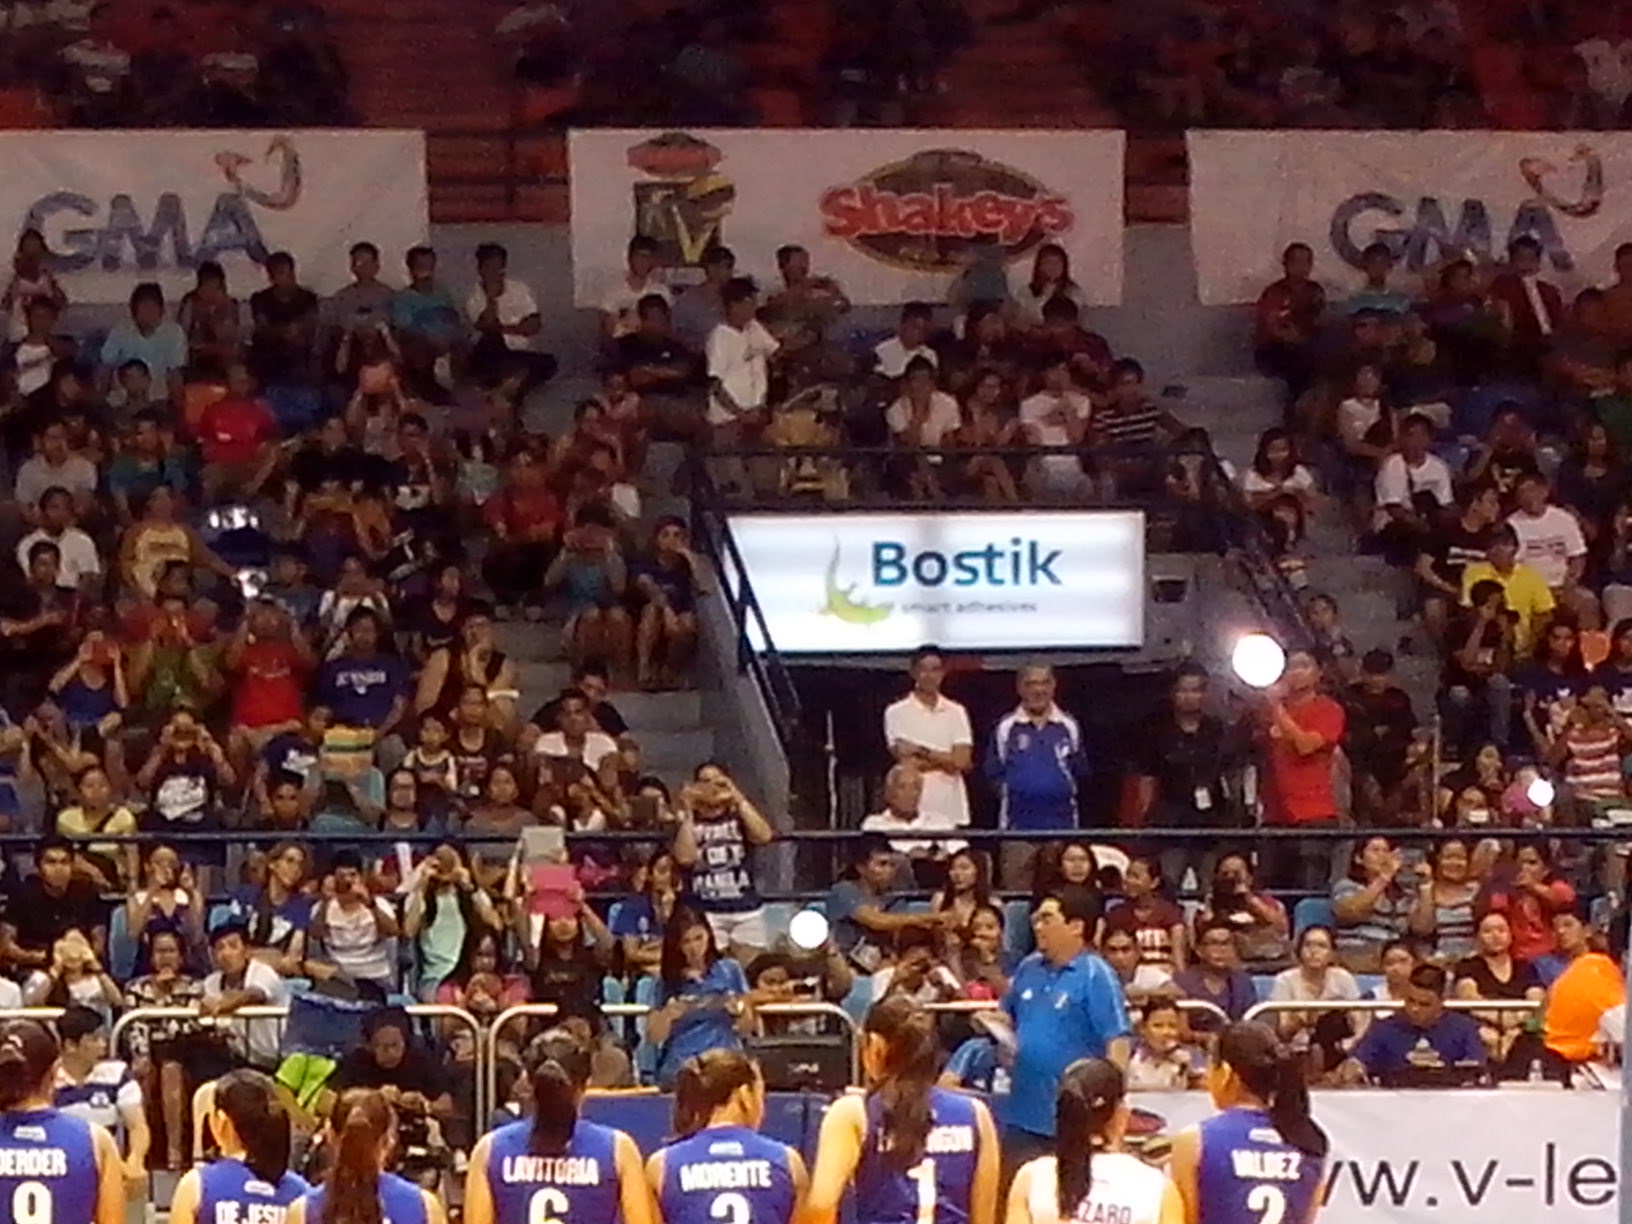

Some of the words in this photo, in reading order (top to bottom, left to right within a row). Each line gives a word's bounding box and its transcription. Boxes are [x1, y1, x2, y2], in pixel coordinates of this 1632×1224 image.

[16, 192, 269, 272] GMA
[872, 537, 1064, 587] Bostik
[680, 1159, 773, 1192] MORENTE
